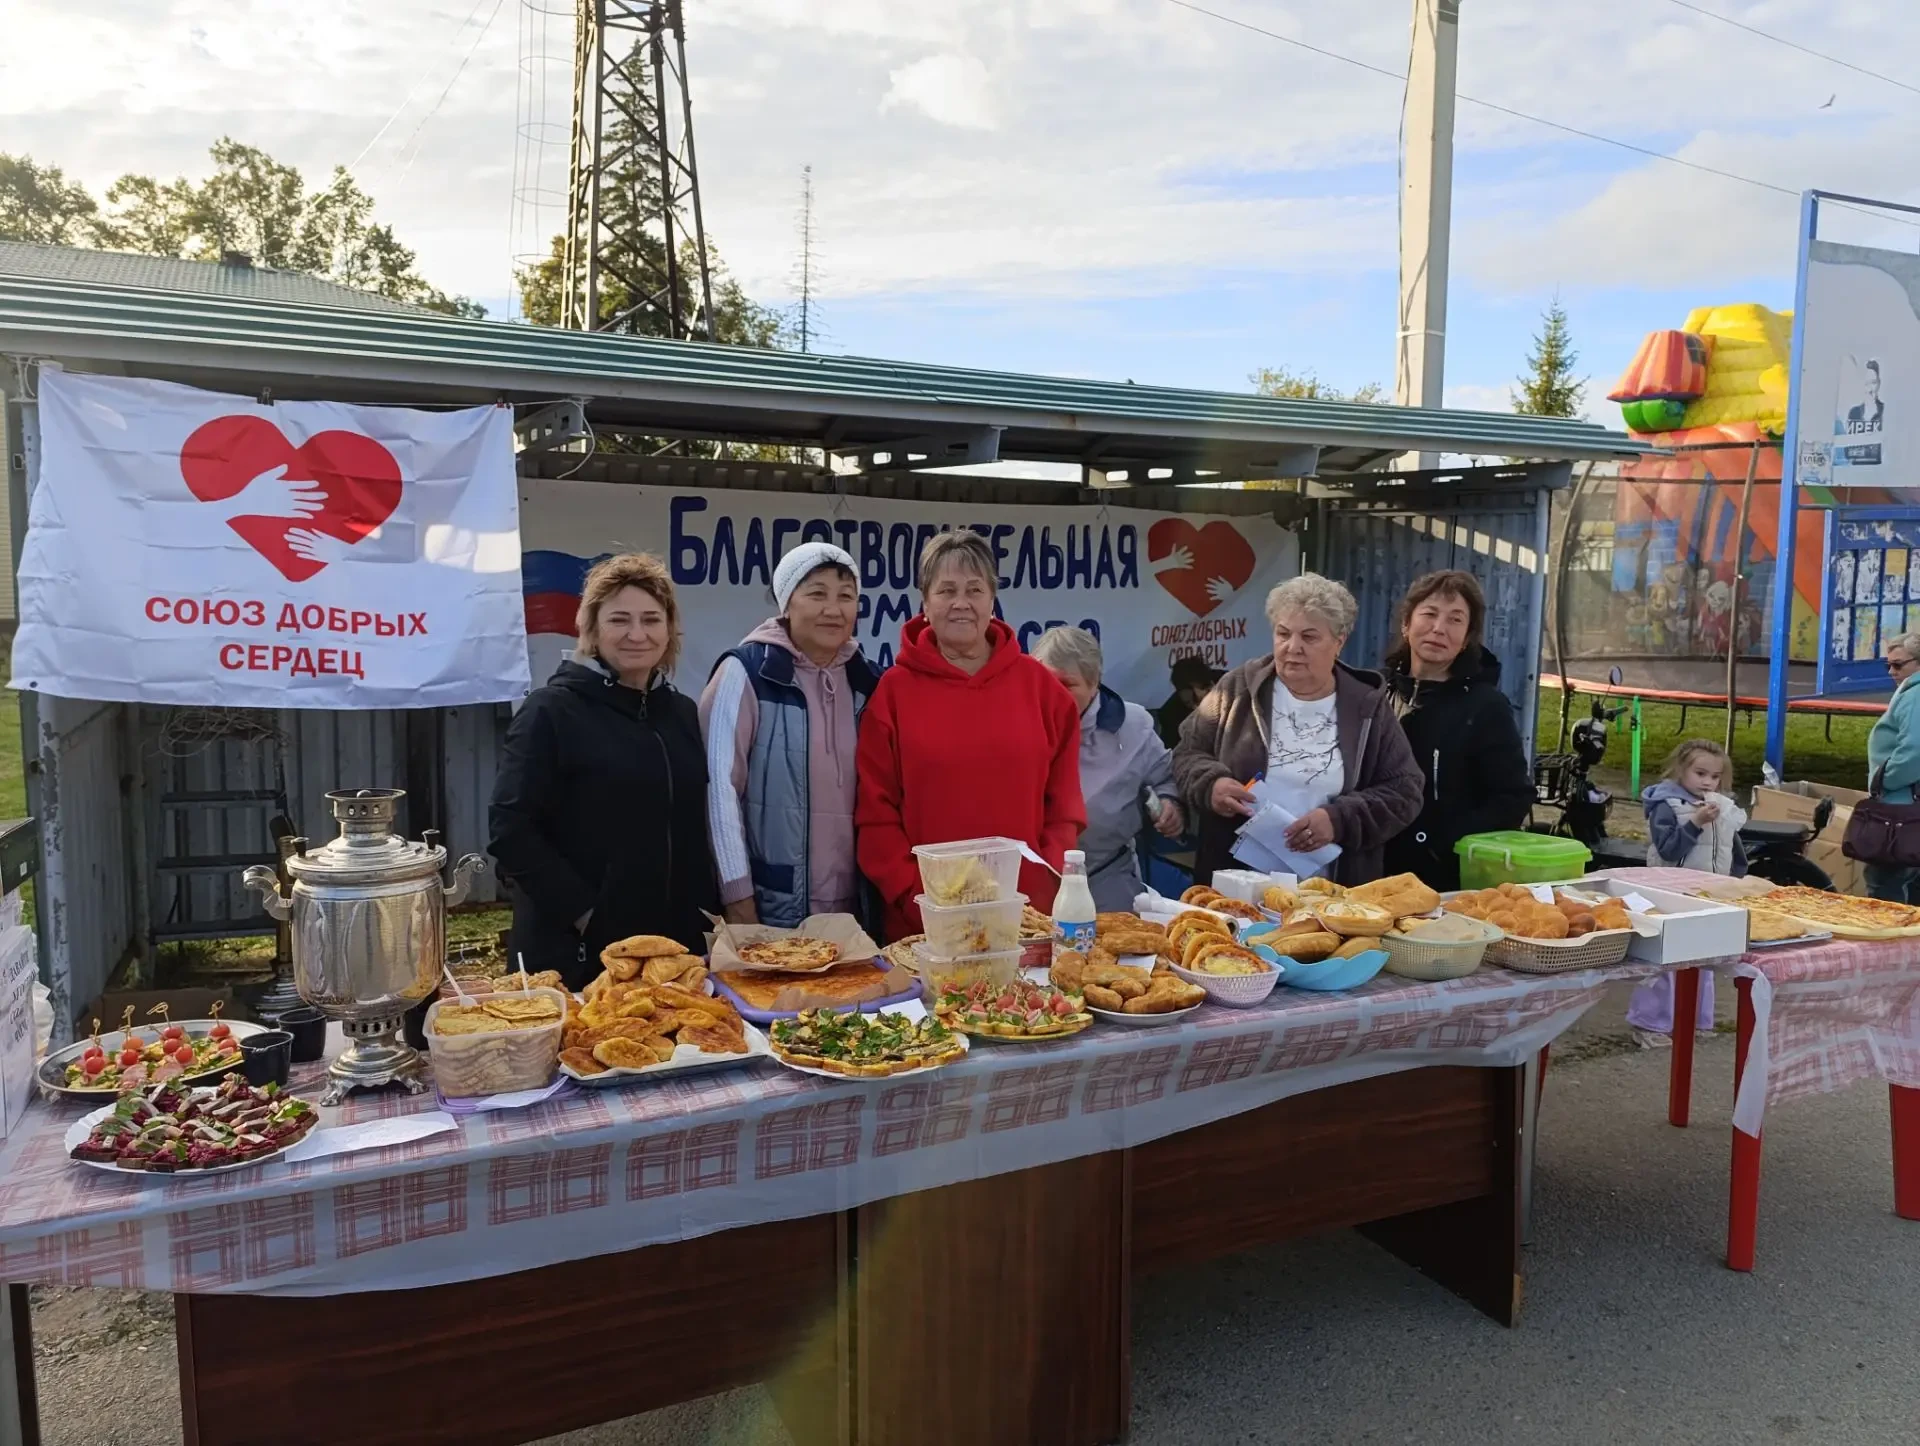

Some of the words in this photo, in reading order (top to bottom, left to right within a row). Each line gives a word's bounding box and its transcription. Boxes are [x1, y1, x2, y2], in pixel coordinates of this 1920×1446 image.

[145, 597, 266, 626] СОЮЗ
[276, 602, 428, 636] ДОБРЫХ
[1151, 624, 1188, 647] СОЮЗ
[1187, 617, 1247, 645] ДОБРЫХ
[219, 643, 365, 680] СЕРДЕЦ
